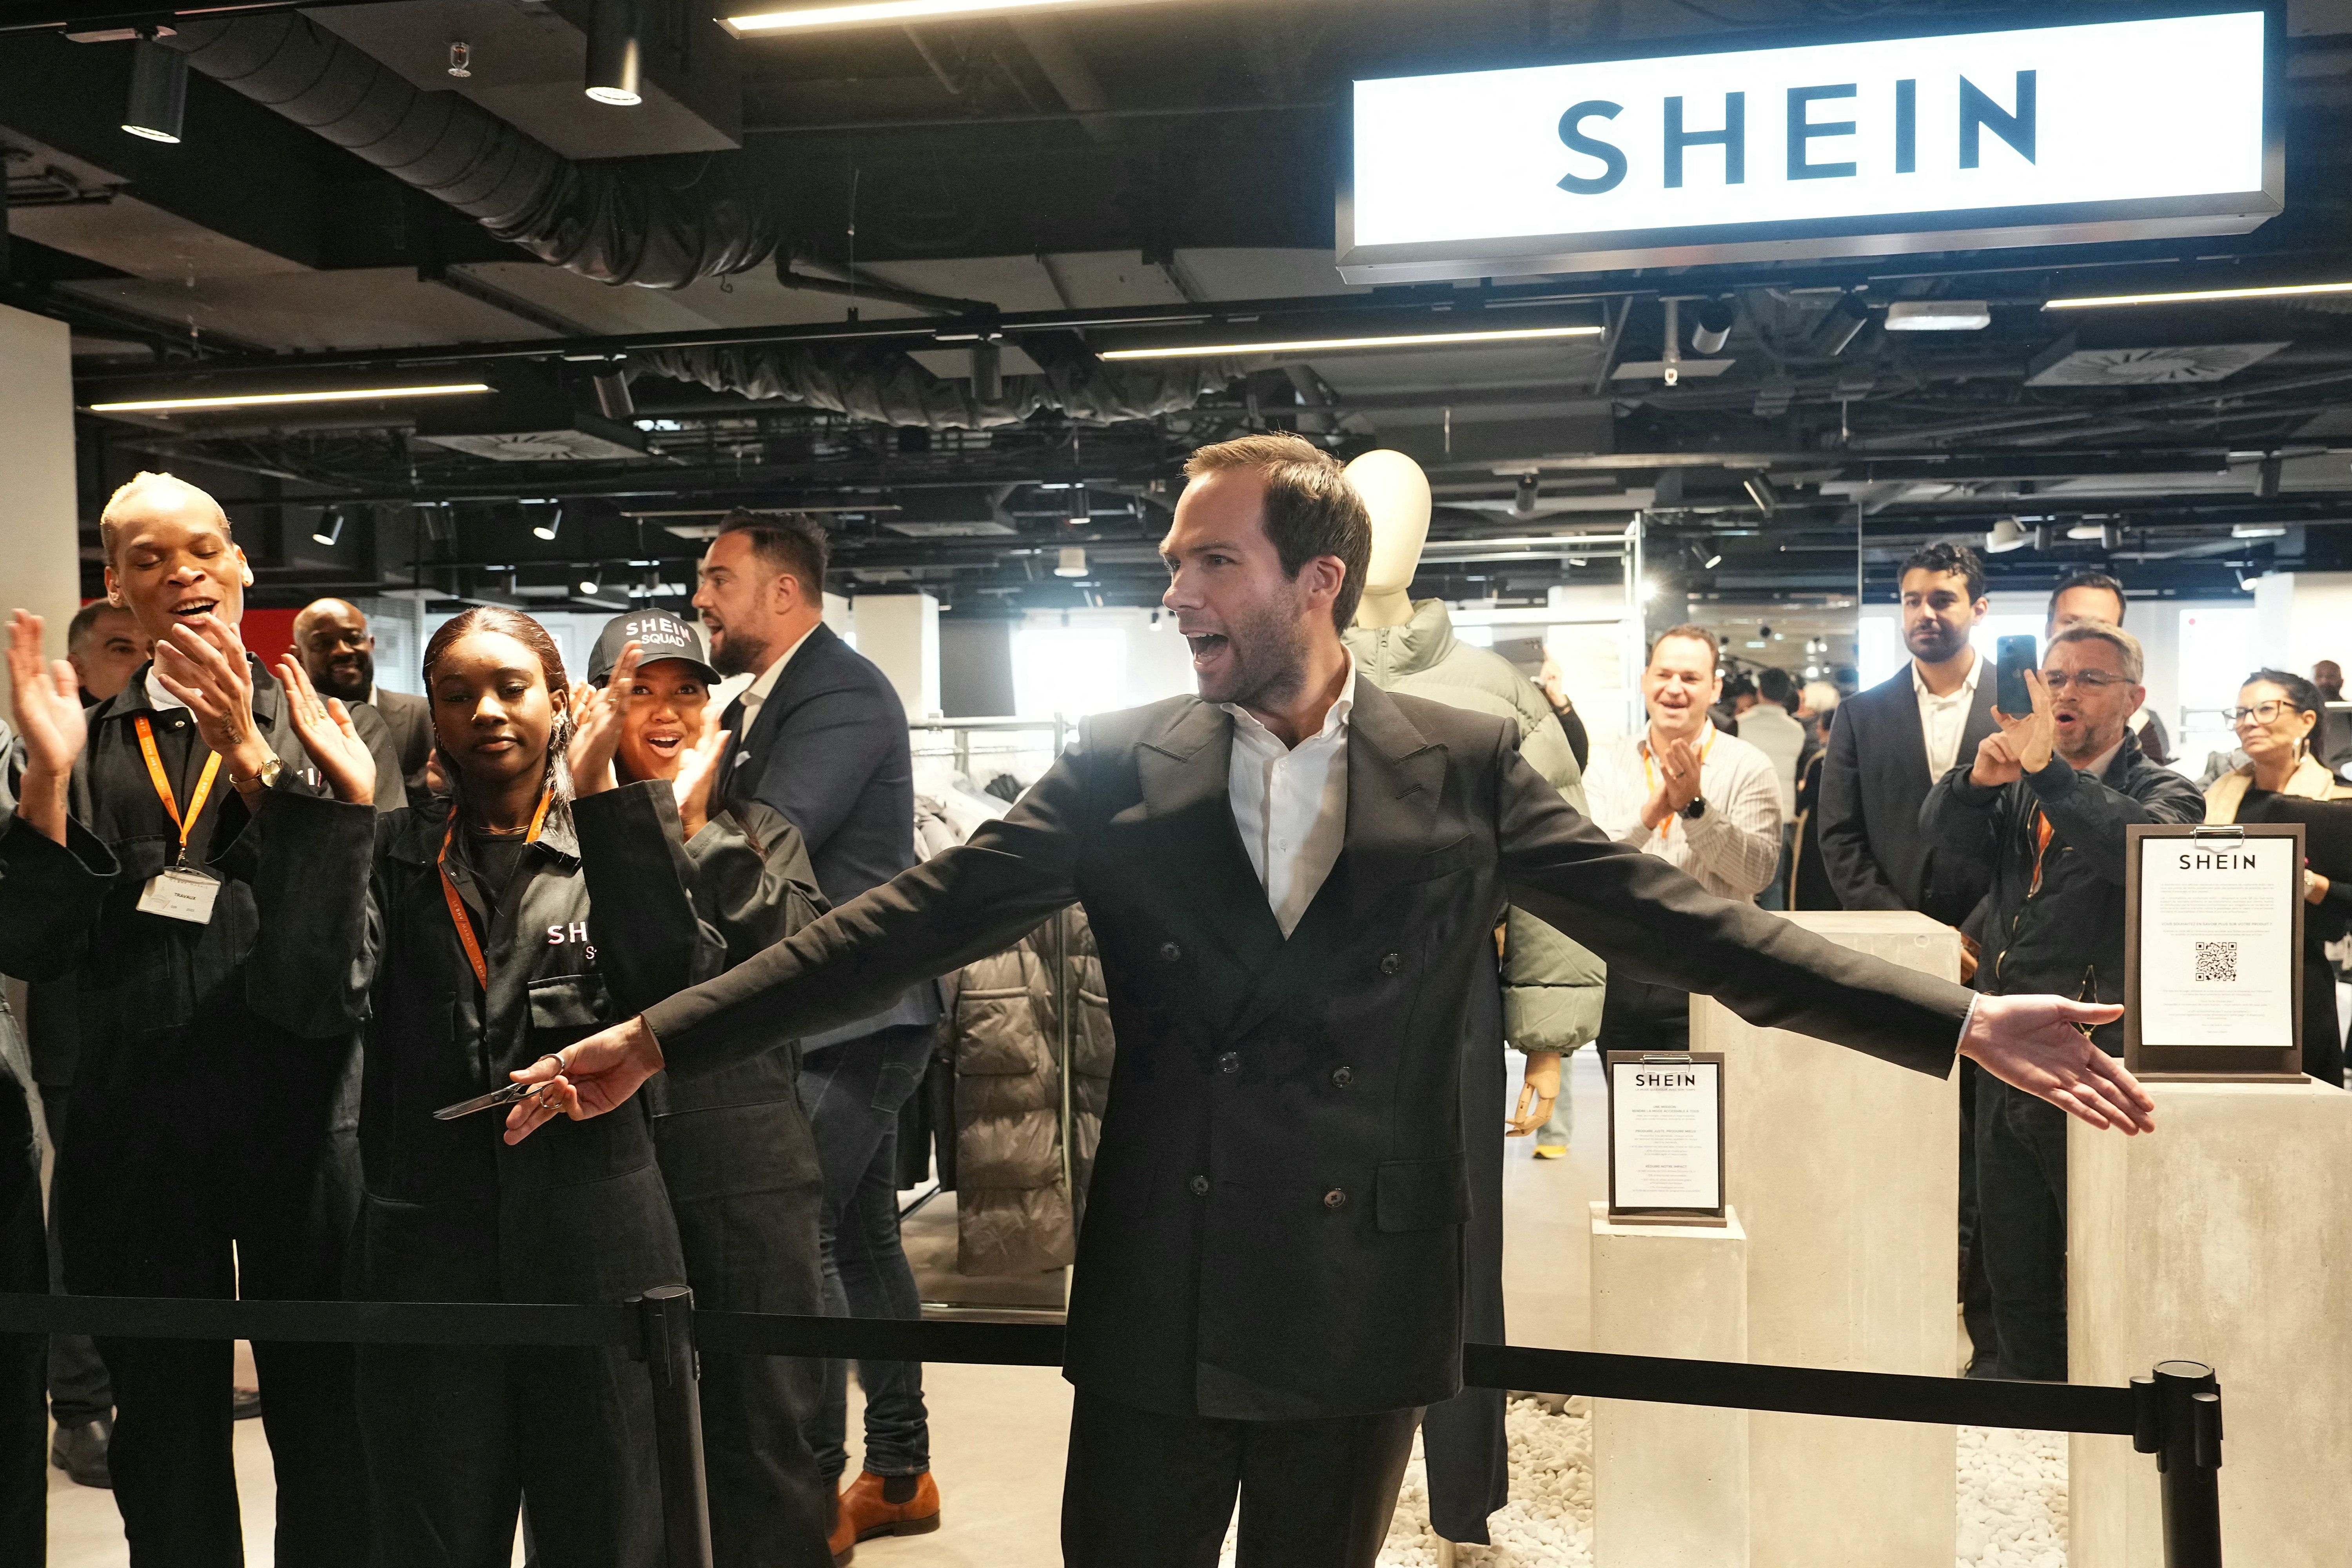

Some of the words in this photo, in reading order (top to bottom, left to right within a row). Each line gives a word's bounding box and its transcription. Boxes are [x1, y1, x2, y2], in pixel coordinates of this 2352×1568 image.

[1556, 70, 2036, 194] SHEIN
[626, 618, 691, 642] SHEIN
[641, 633, 685, 647] SQUAD
[2180, 855, 2255, 869] SHEIN
[174, 892, 197, 900] TRAVAUX
[455, 908, 463, 920] BHV
[1636, 1074, 1695, 1086] SHEIN
